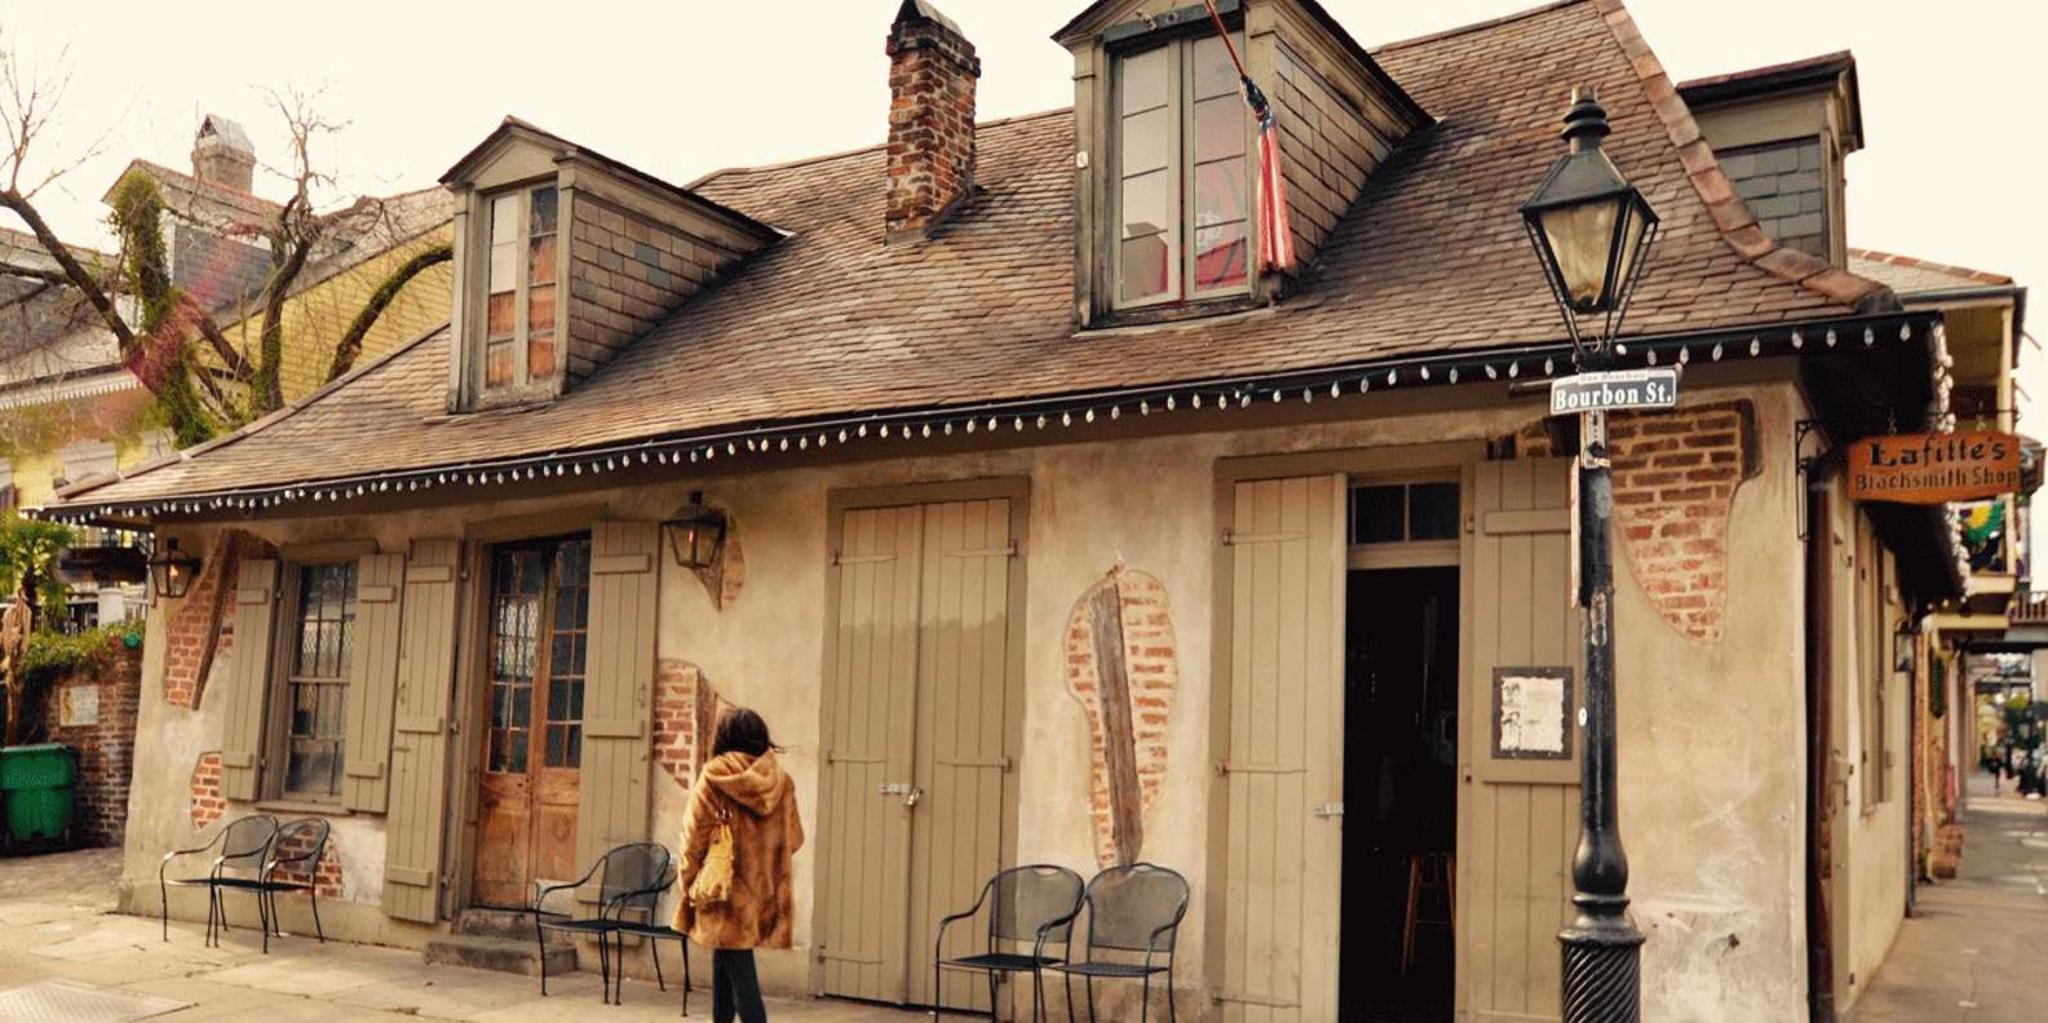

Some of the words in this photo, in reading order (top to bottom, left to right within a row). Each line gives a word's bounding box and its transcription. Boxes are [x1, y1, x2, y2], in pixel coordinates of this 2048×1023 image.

[1555, 383, 1638, 410] Bourbon
[1646, 381, 1672, 403] St.
[1871, 436, 2005, 466] Lafitte's
[1857, 469, 1967, 491] Blacksmith
[1973, 466, 2018, 488] Shop
